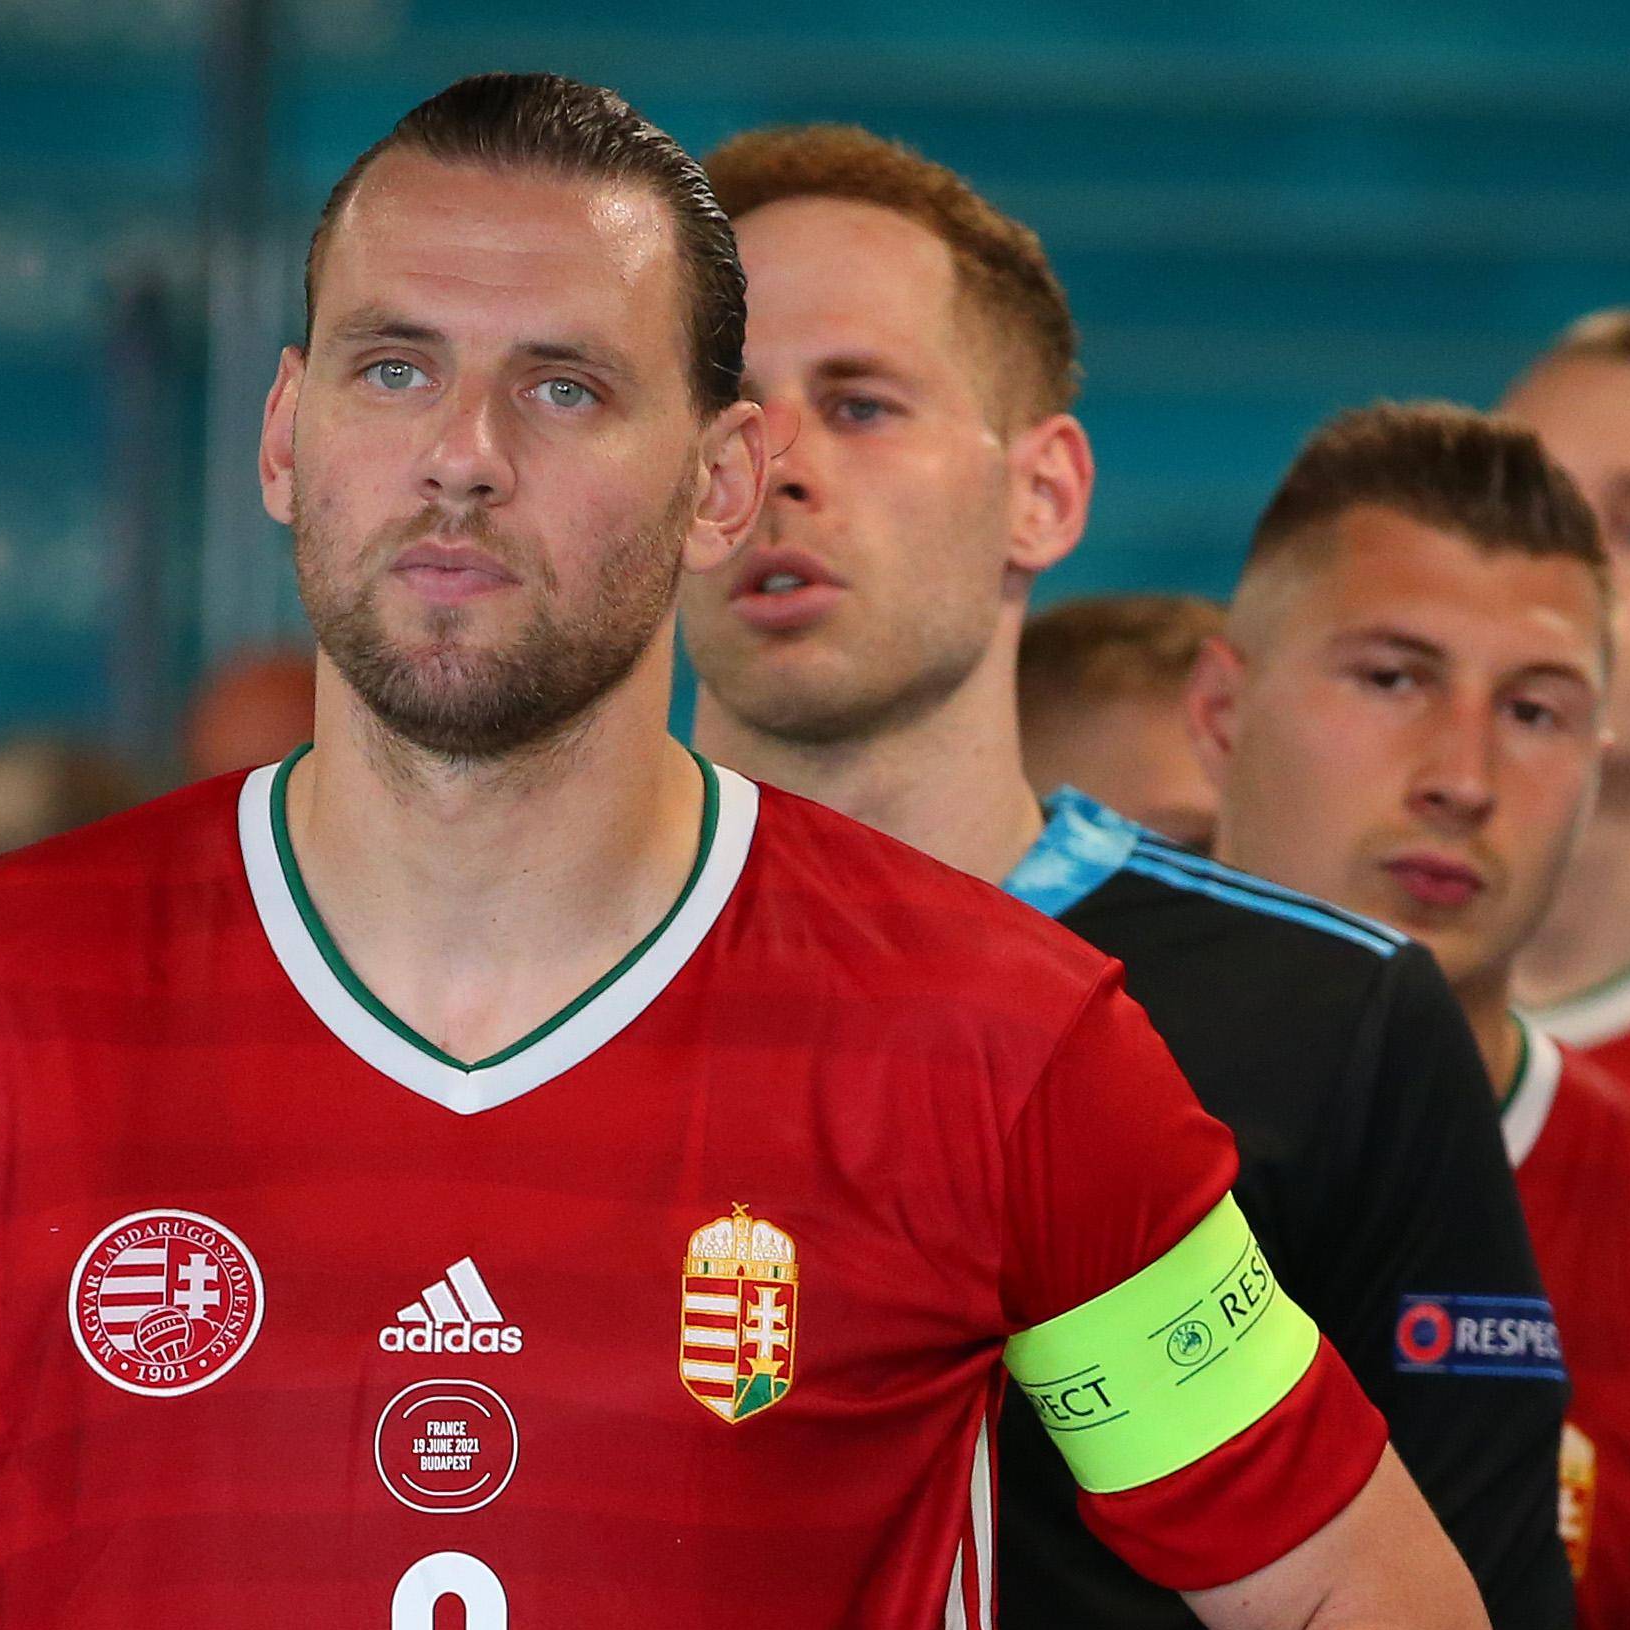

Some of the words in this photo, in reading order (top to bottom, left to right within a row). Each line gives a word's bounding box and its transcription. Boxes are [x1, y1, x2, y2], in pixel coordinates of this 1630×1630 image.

[93, 1220, 217, 1273] LABDARÚGÓ
[83, 1275, 117, 1362] MAGYAR
[379, 1321, 523, 1354] adidas
[135, 1364, 190, 1383] 1901
[427, 1421, 467, 1436] FRANCE
[412, 1438, 425, 1453] 19
[426, 1438, 454, 1453] JUNE
[455, 1438, 480, 1453] 2021
[420, 1455, 471, 1471] BUDAPEST
